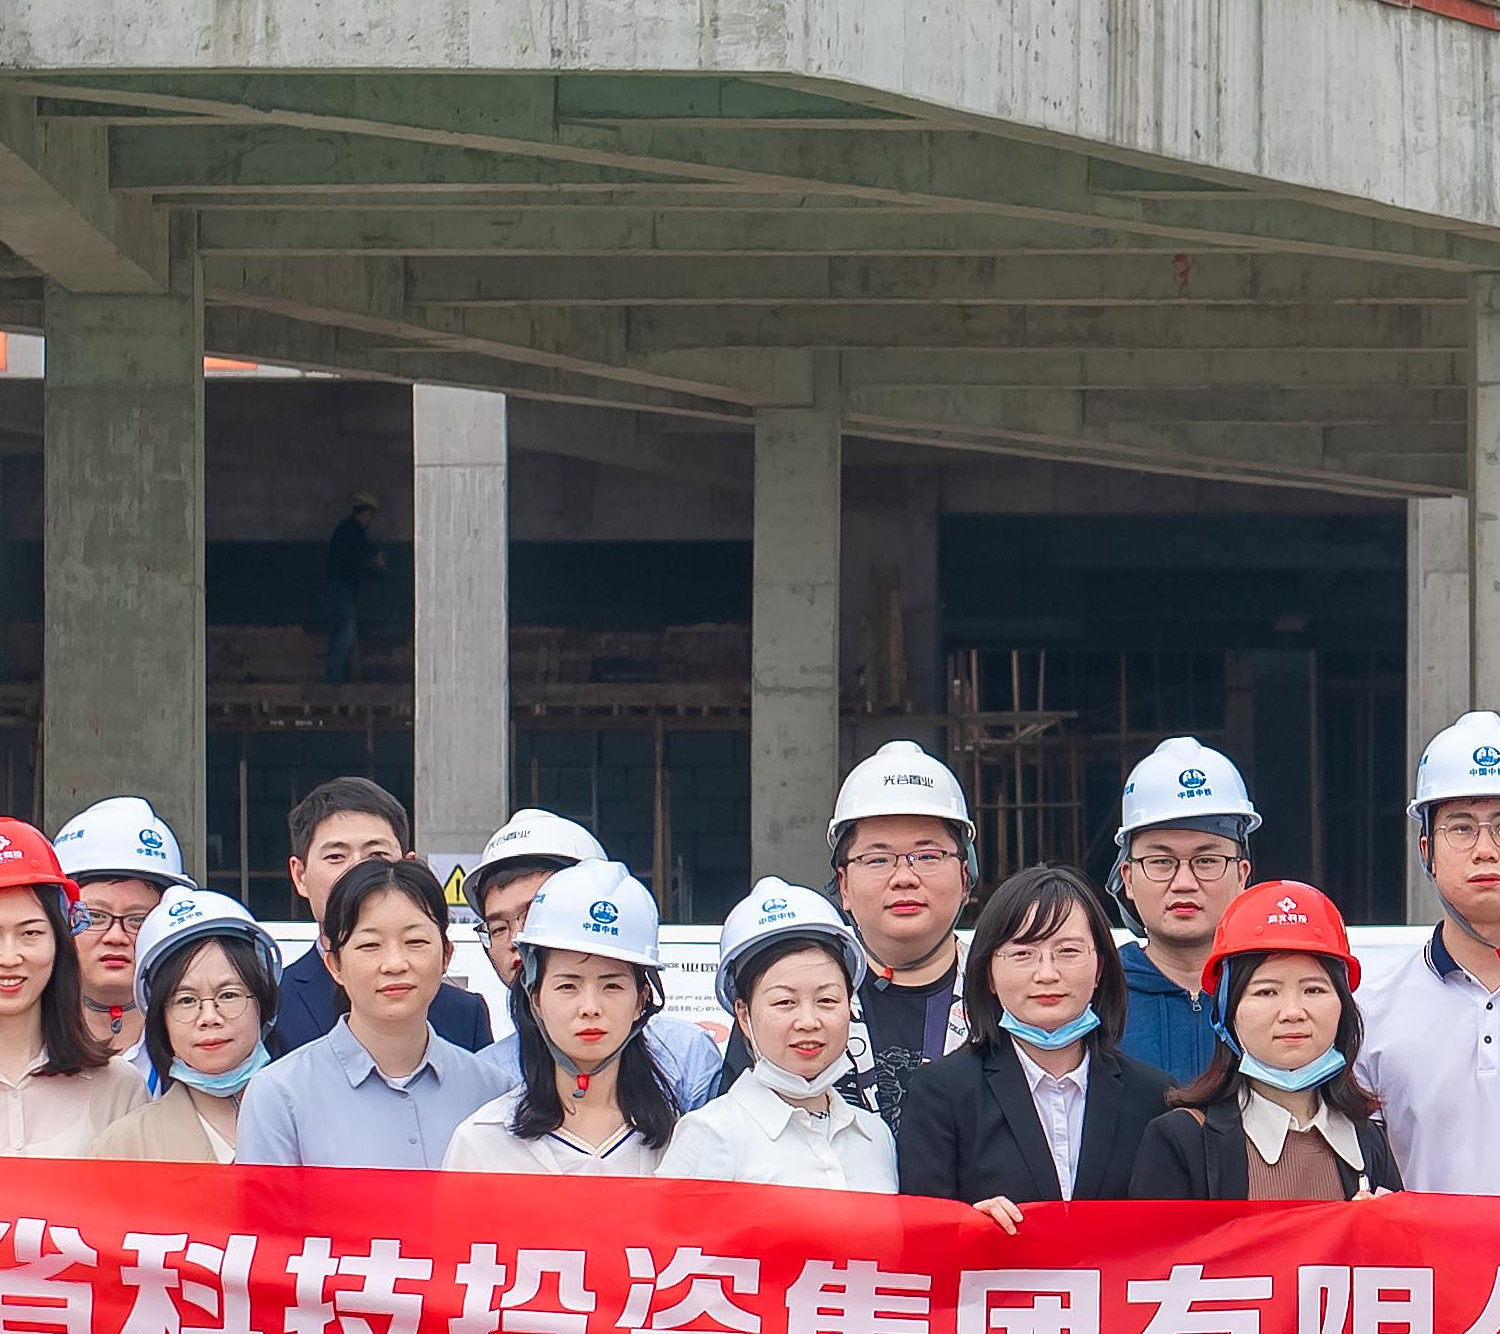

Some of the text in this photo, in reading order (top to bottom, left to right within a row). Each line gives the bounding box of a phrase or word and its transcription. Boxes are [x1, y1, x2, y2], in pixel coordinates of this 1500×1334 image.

[1177, 788, 1213, 800] 中国中铁
[582, 921, 619, 936] 中国中铁
